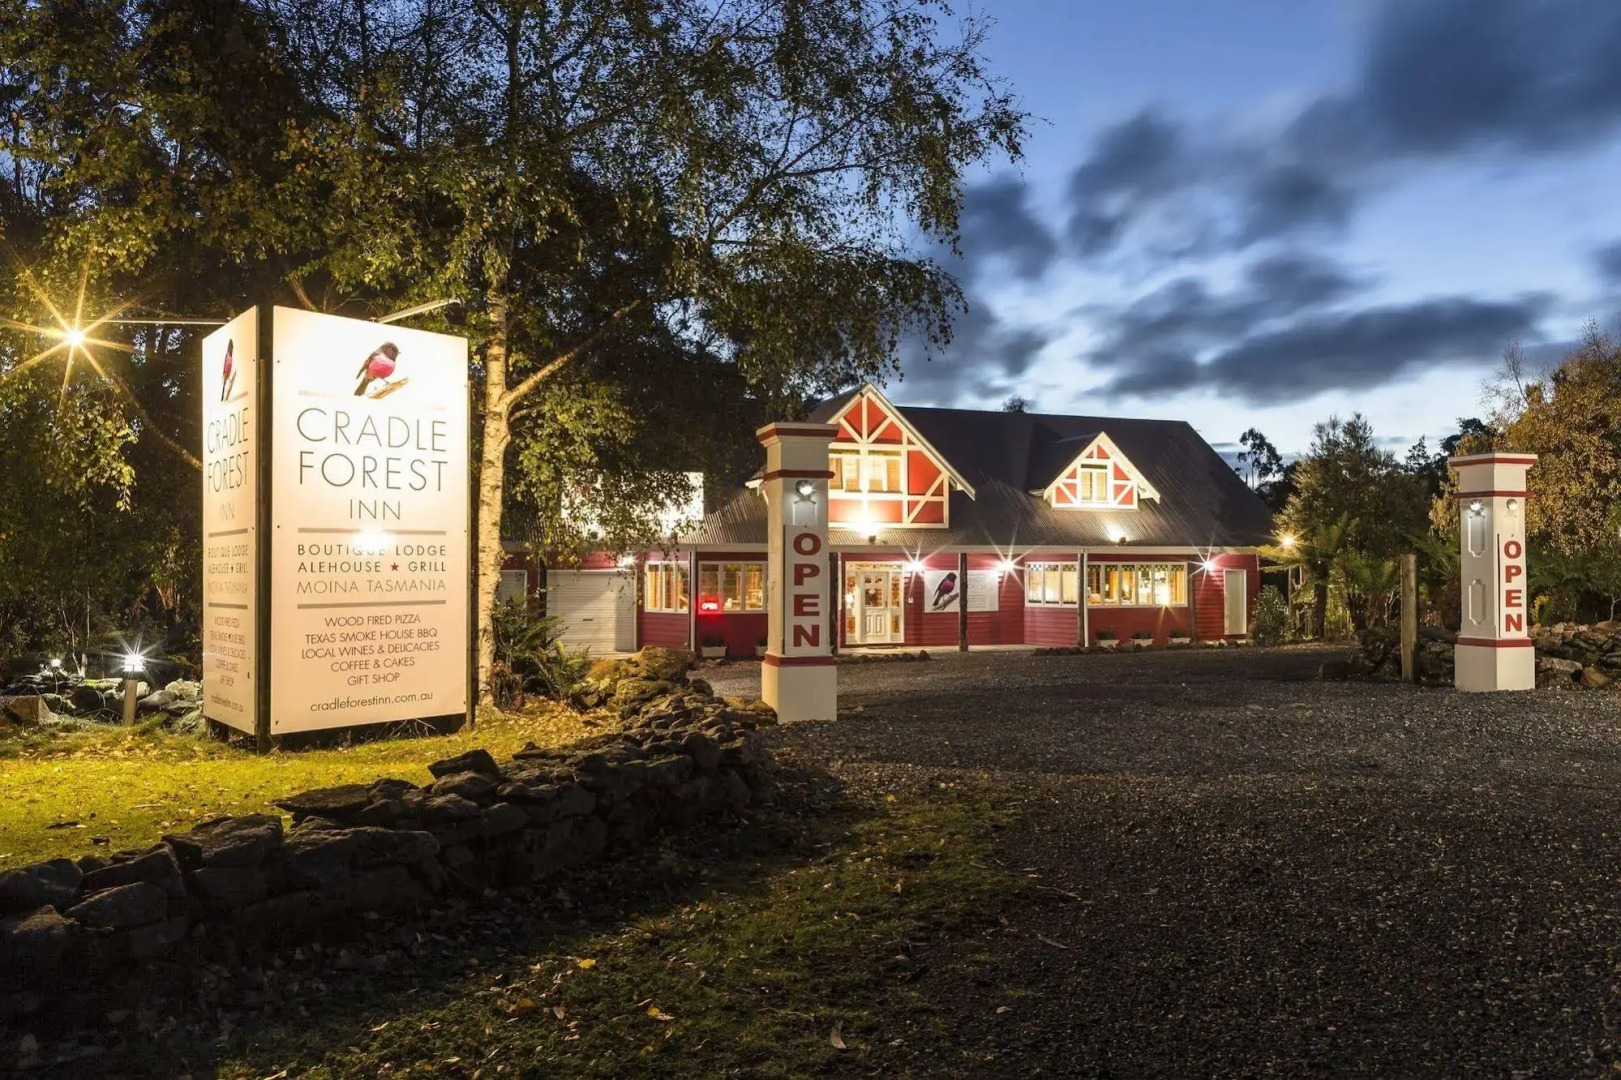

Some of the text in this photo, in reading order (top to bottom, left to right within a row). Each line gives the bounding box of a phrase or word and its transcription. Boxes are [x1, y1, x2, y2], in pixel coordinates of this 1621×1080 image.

[207, 407, 249, 454] CRADLE
[297, 407, 447, 452] CRADLE
[207, 451, 249, 493] FOREST
[299, 450, 448, 492] FOREST
[219, 501, 235, 520] INN
[349, 499, 401, 520] INN
[298, 544, 446, 556] BOUTIQUE LODGE
[297, 561, 446, 573] ALEHOUSE GRILL
[296, 578, 446, 594] MOINA TASMANIA
[793, 532, 822, 648] OPEN
[1503, 540, 1523, 632] OPEN
[325, 614, 421, 627] WOOD FIRED PIZZA
[305, 628, 438, 645] TEXAS SMOKE HOUSE BBQ
[301, 641, 440, 660] LOCAL WINES & DELICACIES
[330, 657, 415, 672] COFFEE & CAKES
[347, 672, 401, 686] GIFT SHOP
[310, 692, 433, 712] cradleforestinn.com.au
